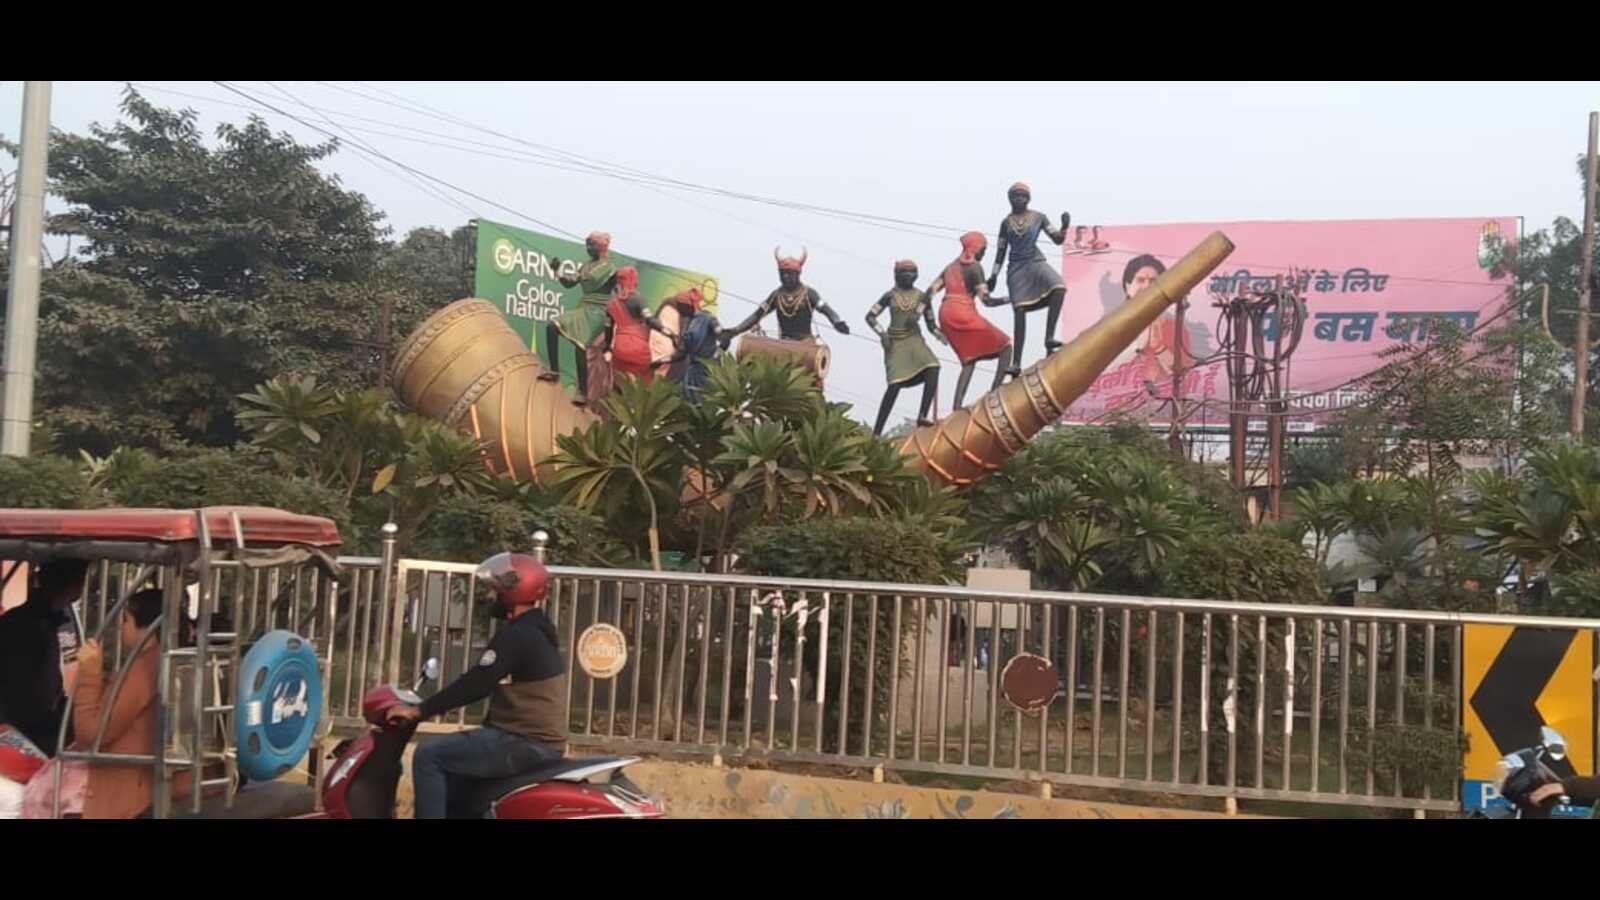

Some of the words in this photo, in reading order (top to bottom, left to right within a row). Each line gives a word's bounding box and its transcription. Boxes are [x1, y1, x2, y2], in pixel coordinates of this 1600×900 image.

[516, 279, 563, 306] Color
[1315, 269, 1339, 293] के
[1341, 267, 1391, 293] लिए
[1314, 312, 1379, 342] बस
